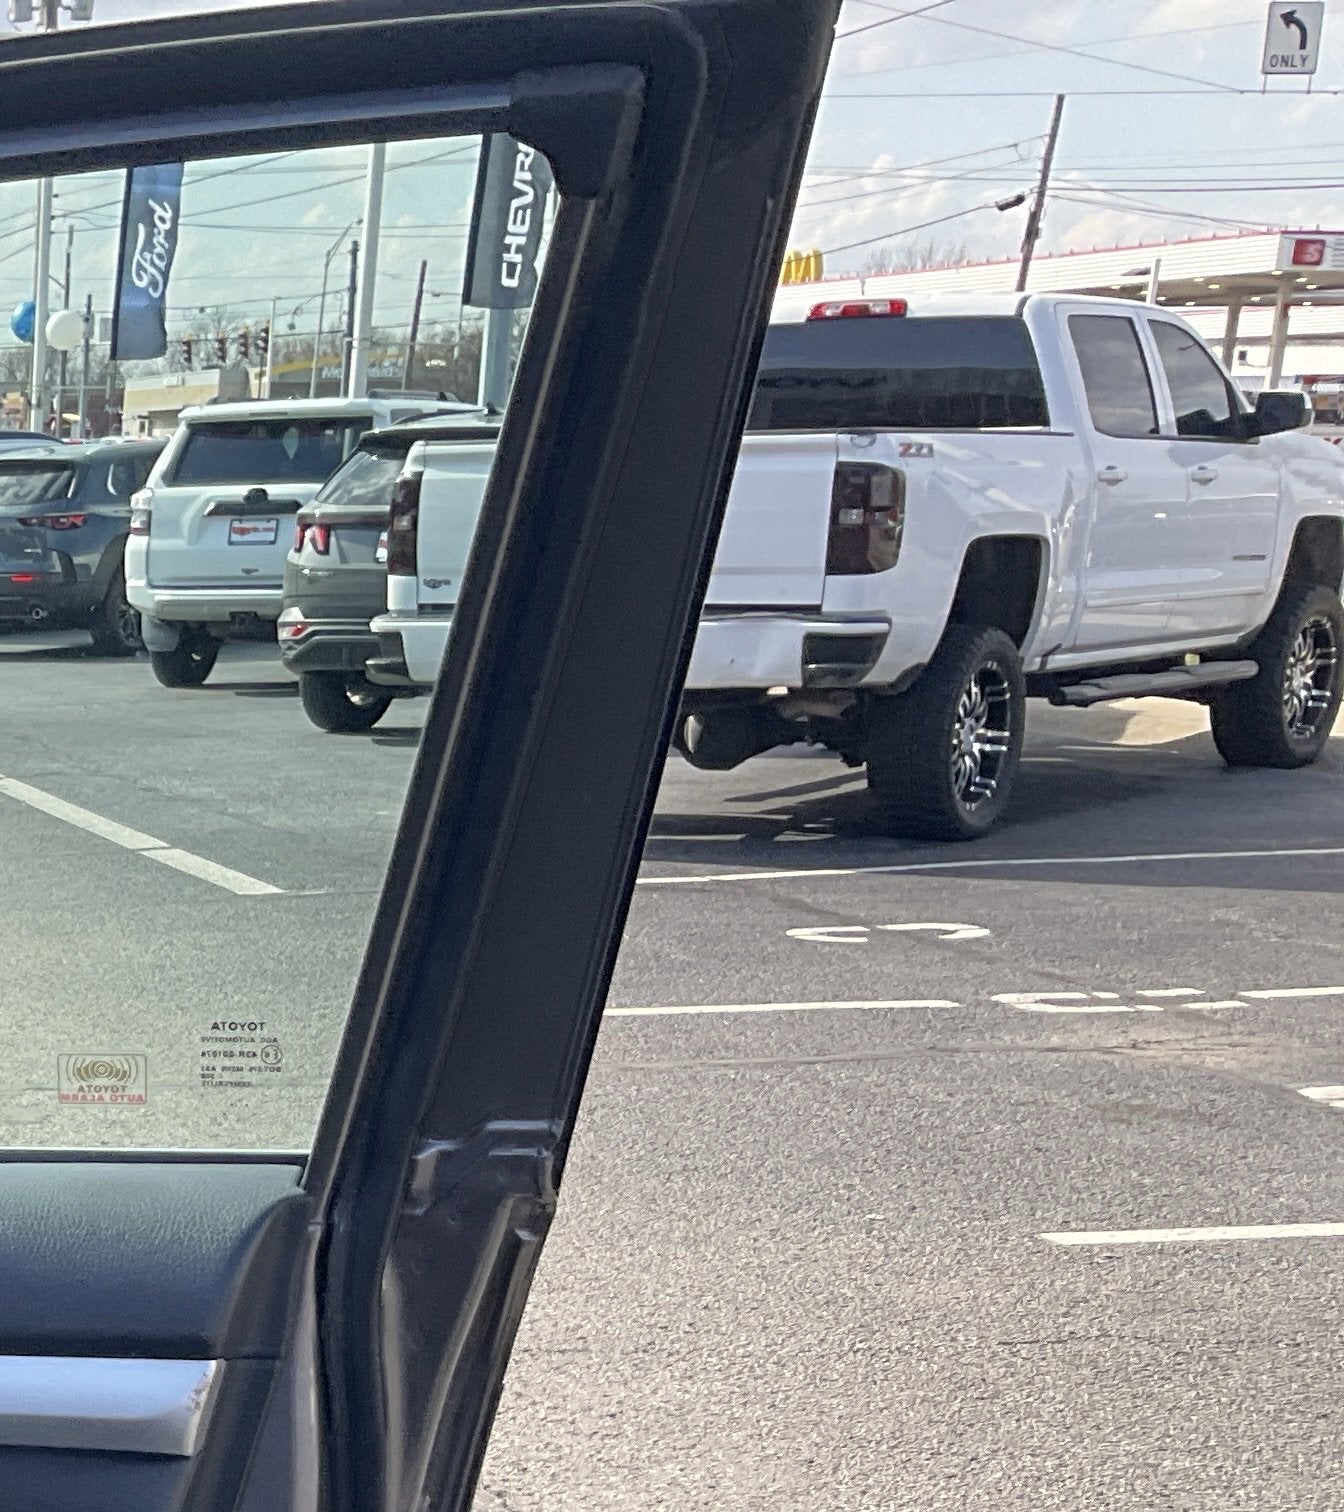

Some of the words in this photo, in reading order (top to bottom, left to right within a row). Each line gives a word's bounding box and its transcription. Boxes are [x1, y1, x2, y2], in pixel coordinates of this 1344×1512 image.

[1269, 54, 1310, 68] ONLY
[132, 199, 173, 298] Ford
[898, 442, 935, 458] Z71
